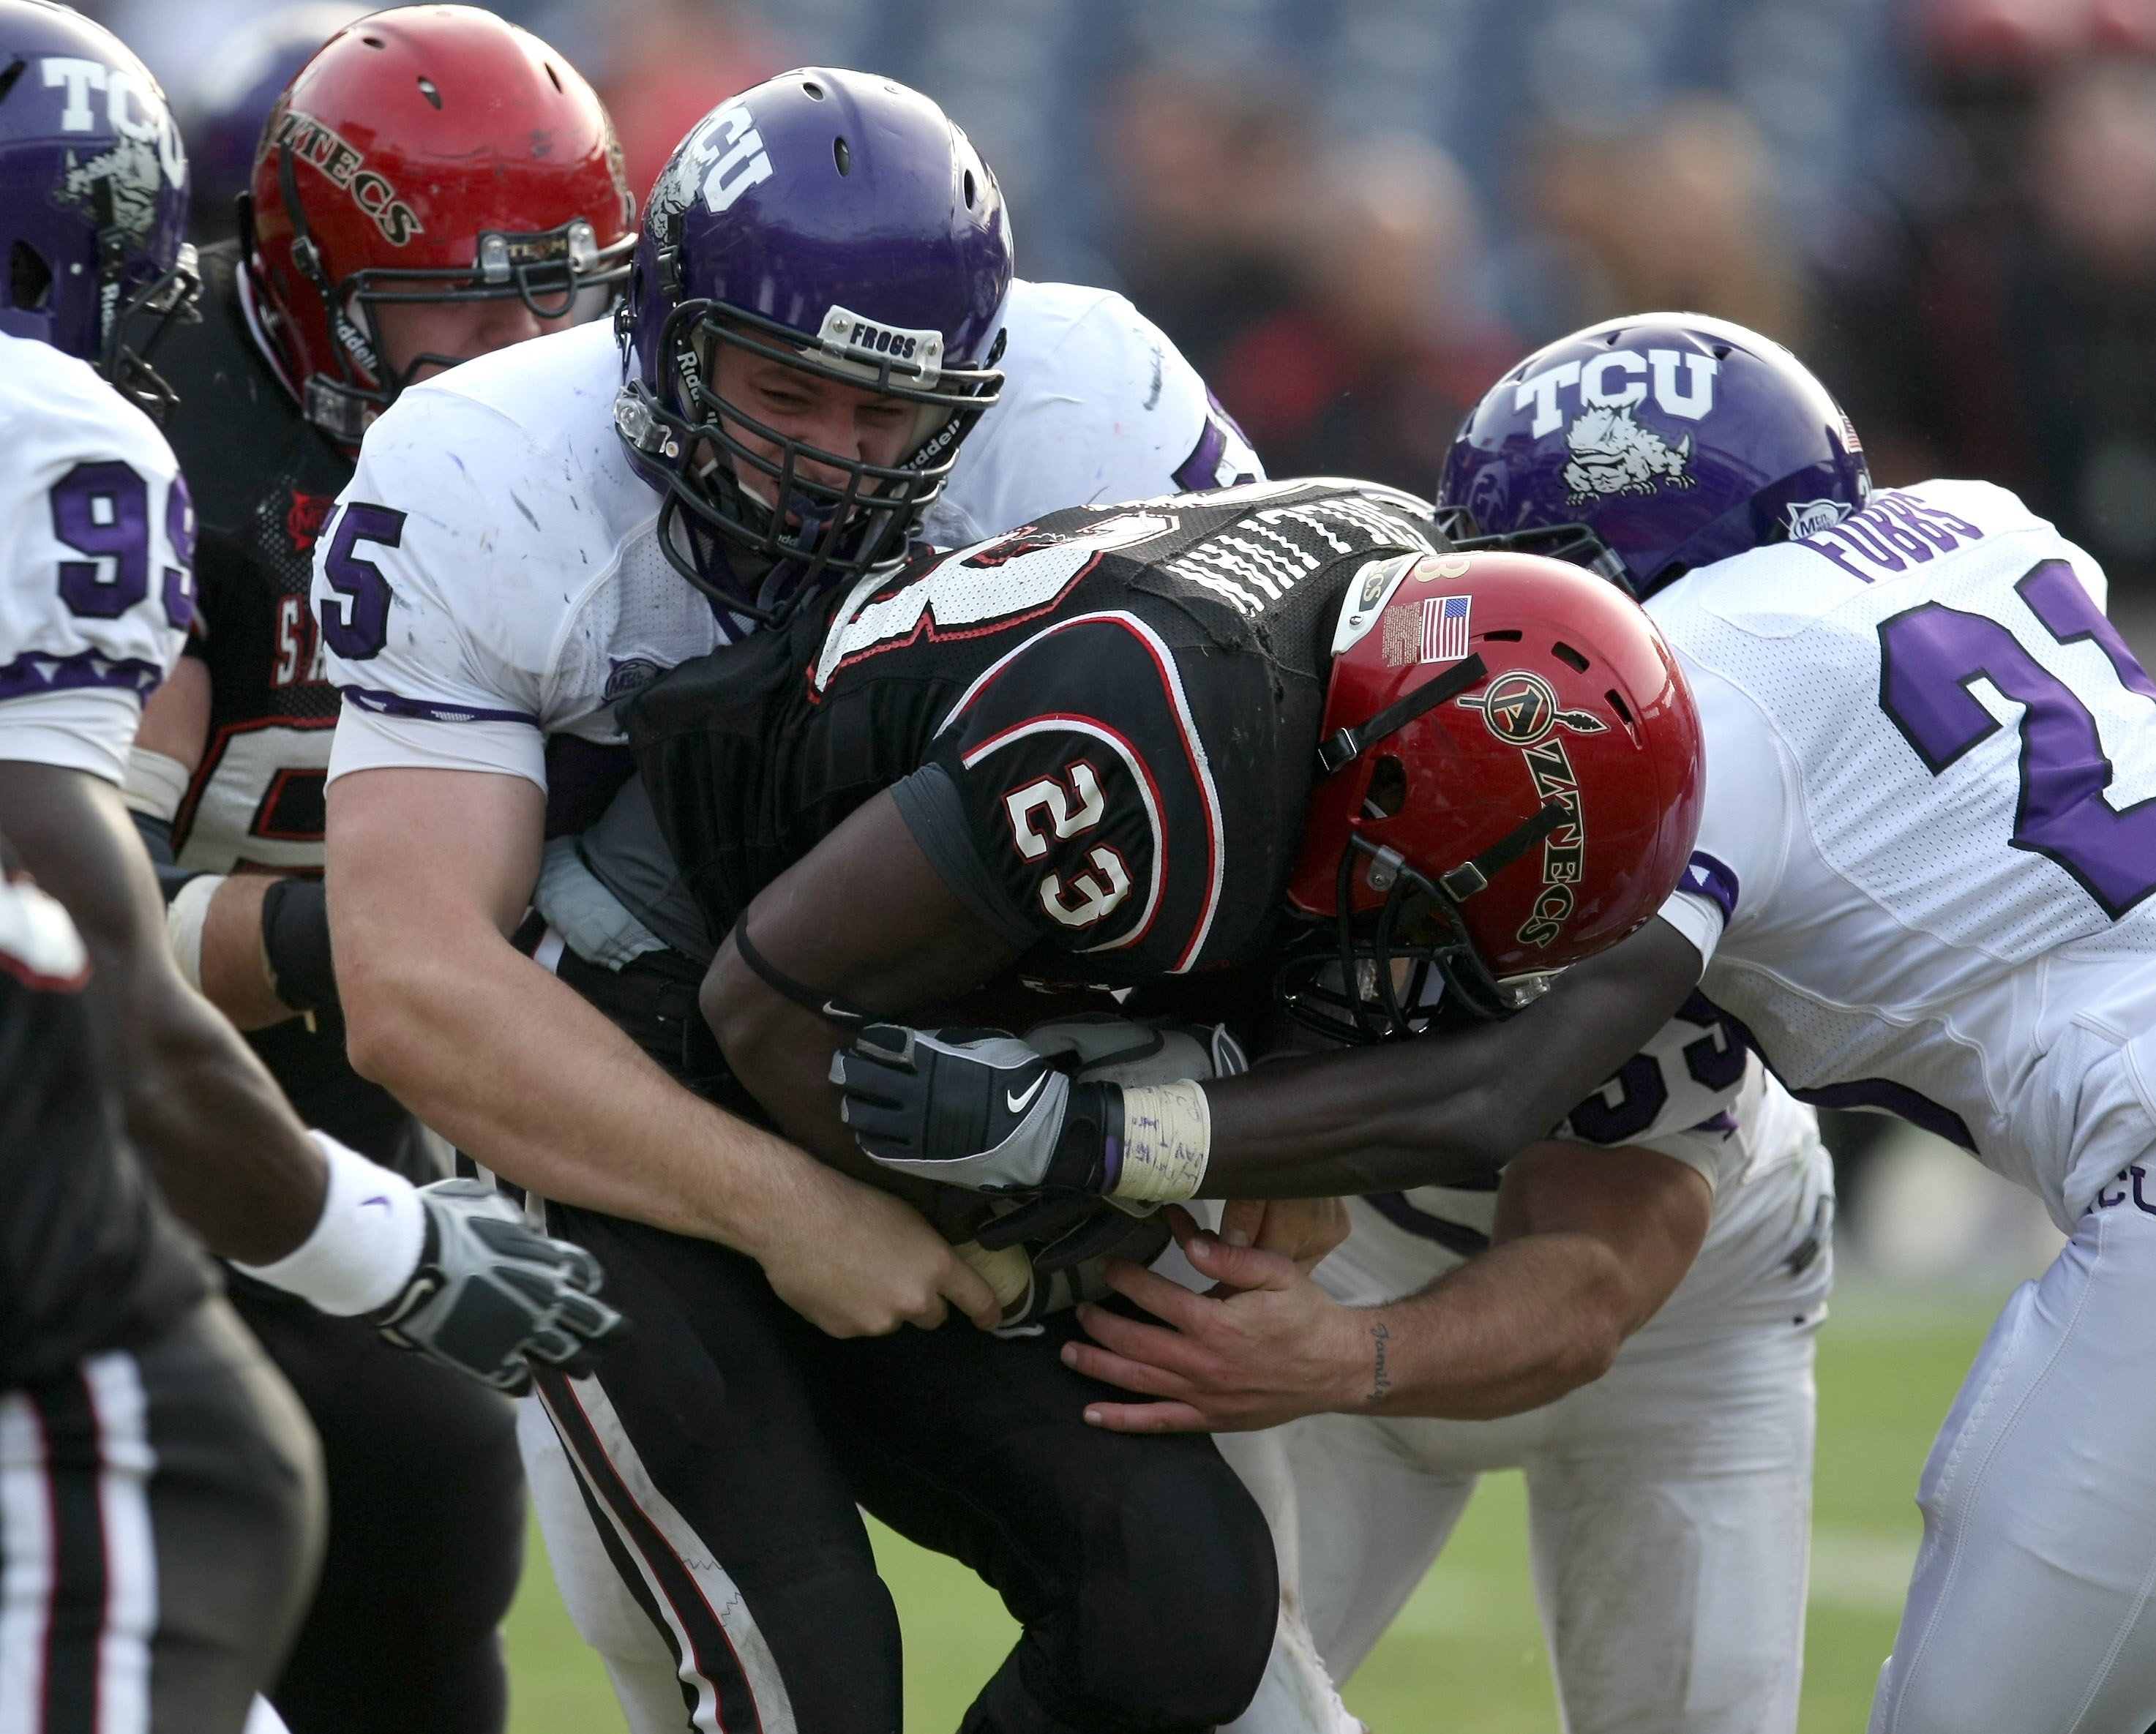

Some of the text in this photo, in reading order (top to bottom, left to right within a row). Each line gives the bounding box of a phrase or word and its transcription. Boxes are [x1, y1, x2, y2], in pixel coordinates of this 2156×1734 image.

[41, 57, 188, 189] TCU
[692, 106, 774, 213] CU
[850, 322, 917, 359] FROGS
[1514, 349, 1718, 440] TCU
[320, 501, 409, 661] 5
[1001, 758, 1134, 930] 23
